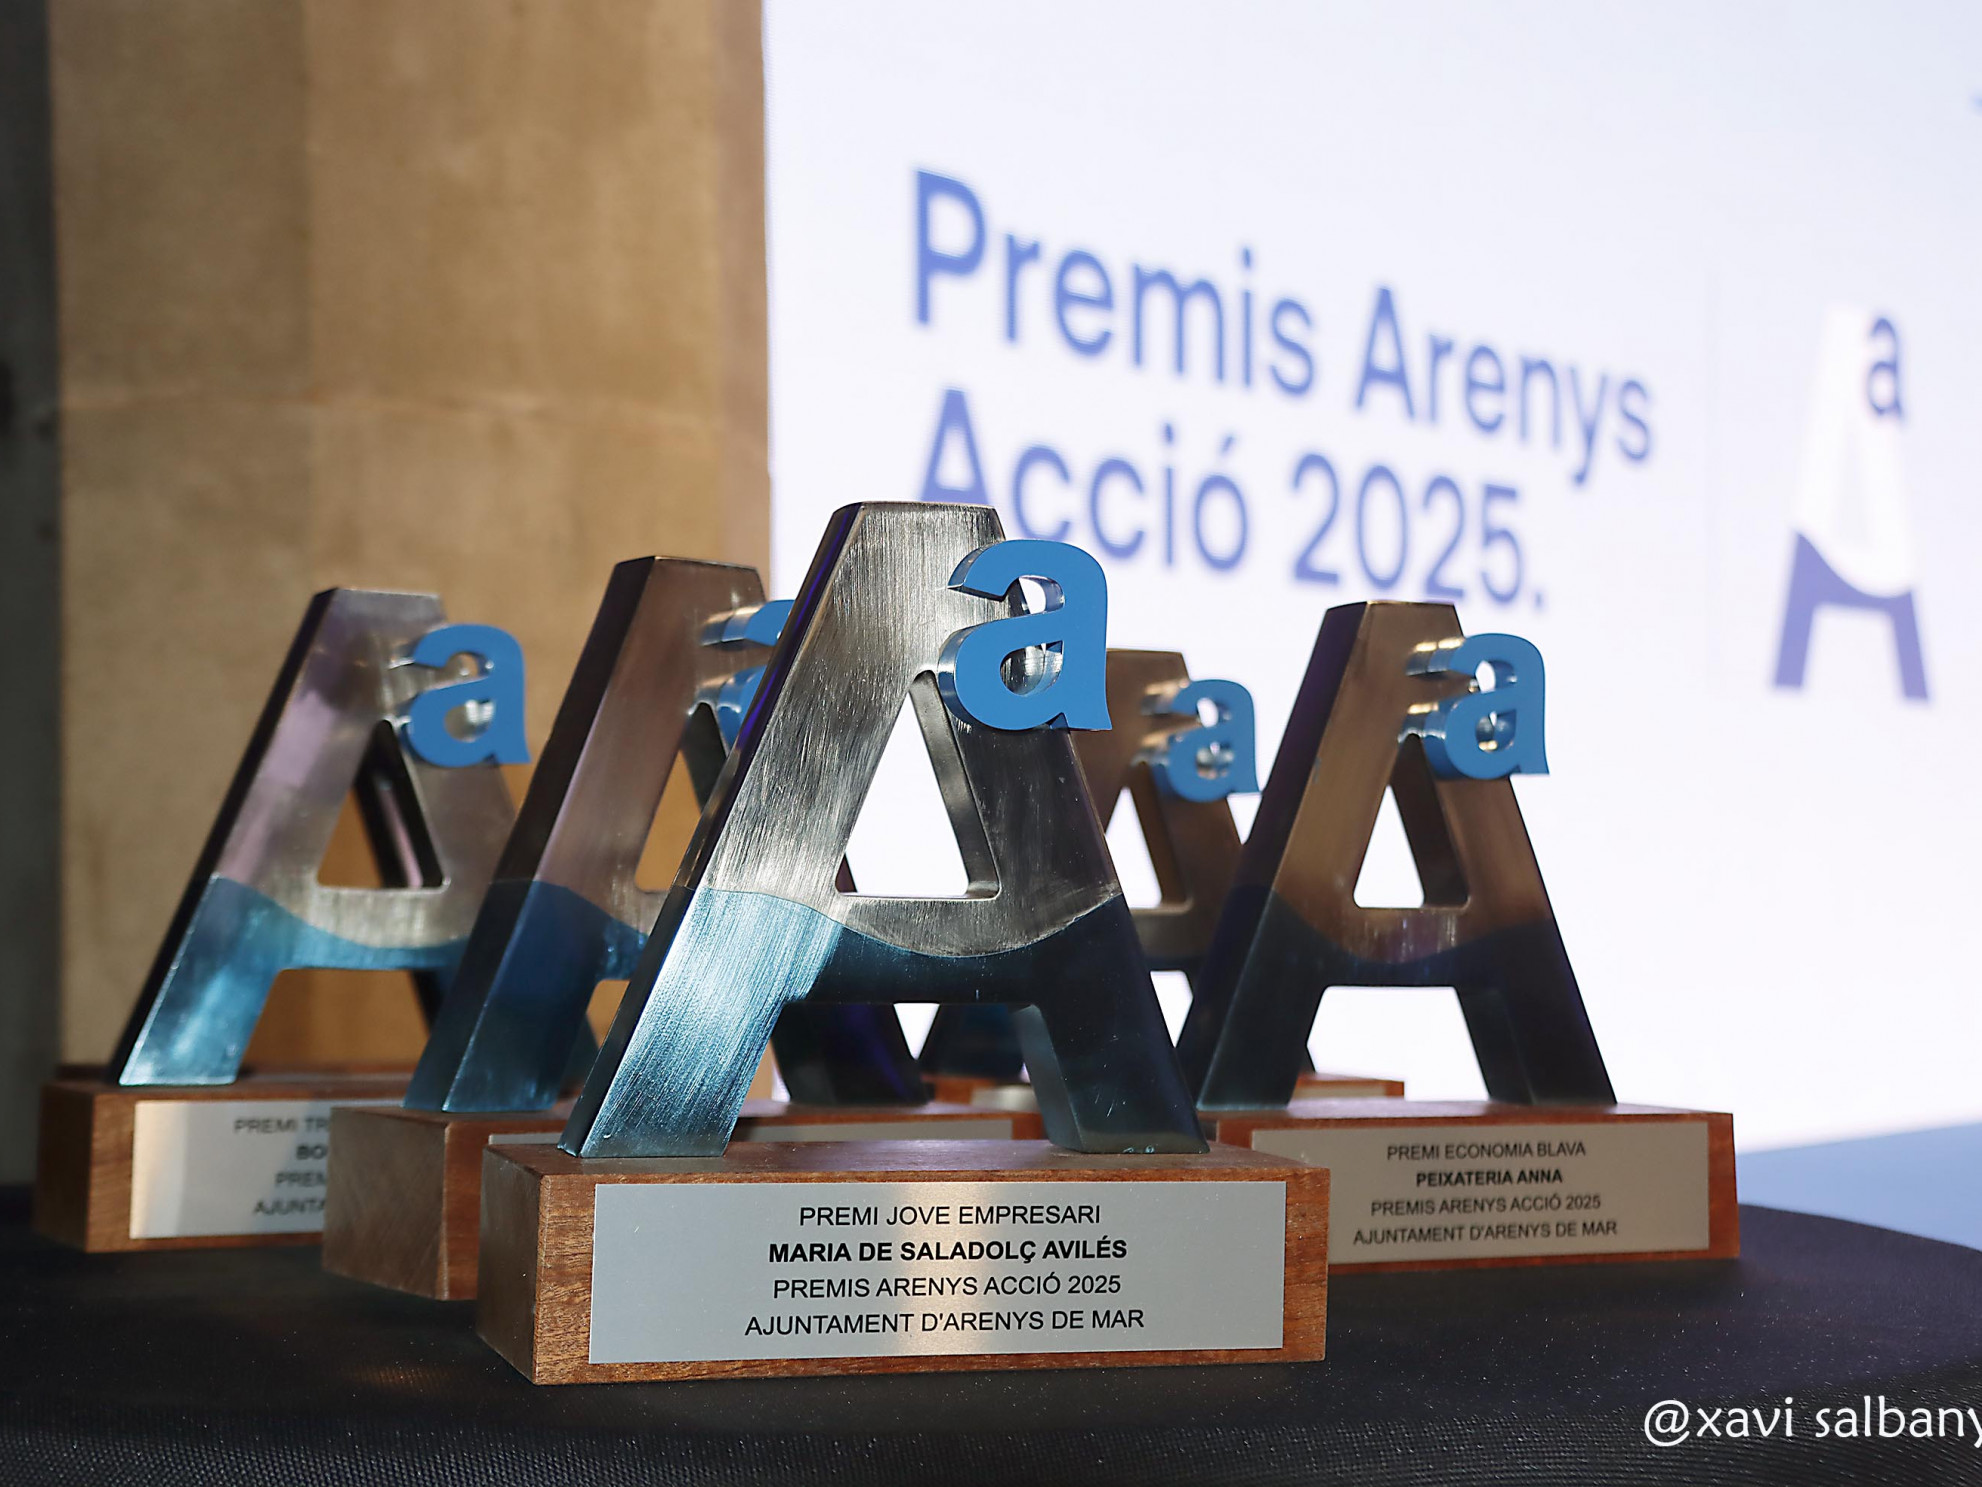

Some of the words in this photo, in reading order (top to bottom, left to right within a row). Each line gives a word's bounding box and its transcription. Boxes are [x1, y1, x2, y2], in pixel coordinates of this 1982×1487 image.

[913, 164, 1315, 398] Premis
[1352, 286, 1655, 487] Arenys
[918, 385, 1252, 573] Acció
[1291, 450, 1546, 613] 2025.
[233, 1116, 298, 1134] PREMI
[1387, 1143, 1440, 1162] PREMI
[1444, 1141, 1534, 1161] ECONOMIA
[1536, 1140, 1587, 1158] BLAVA
[1416, 1168, 1514, 1189] PEIXATERIA
[1516, 1167, 1564, 1185] ANNA
[799, 1206, 879, 1227] PREMI
[885, 1205, 951, 1227] JOVE
[956, 1203, 1101, 1226] EMPRESARI
[1371, 1198, 1436, 1217] PREMIS
[1438, 1196, 1508, 1215] ARENYS
[1510, 1191, 1562, 1212] ACCIÓ
[1565, 1193, 1601, 1211] 2025
[1353, 1224, 1465, 1246] AJUNTAMENT
[1470, 1221, 1551, 1242] D'ARENYS
[1556, 1219, 1578, 1238] DE
[1581, 1218, 1618, 1238] MAR
[769, 1240, 853, 1263] MARIA
[858, 1240, 895, 1262] DE
[899, 1239, 1036, 1268] SALADOLÇ
[1041, 1233, 1128, 1260] AVILÉS
[773, 1277, 871, 1299] PREMIS
[875, 1275, 978, 1298] ARENYS
[982, 1270, 1061, 1296] ACCIÓ
[1067, 1273, 1121, 1296] 2025
[744, 1311, 914, 1338] AJUNTAMENT
[921, 1309, 1045, 1334] D'ARENYS
[1052, 1309, 1086, 1331] DE
[1092, 1308, 1145, 1330] MAR
